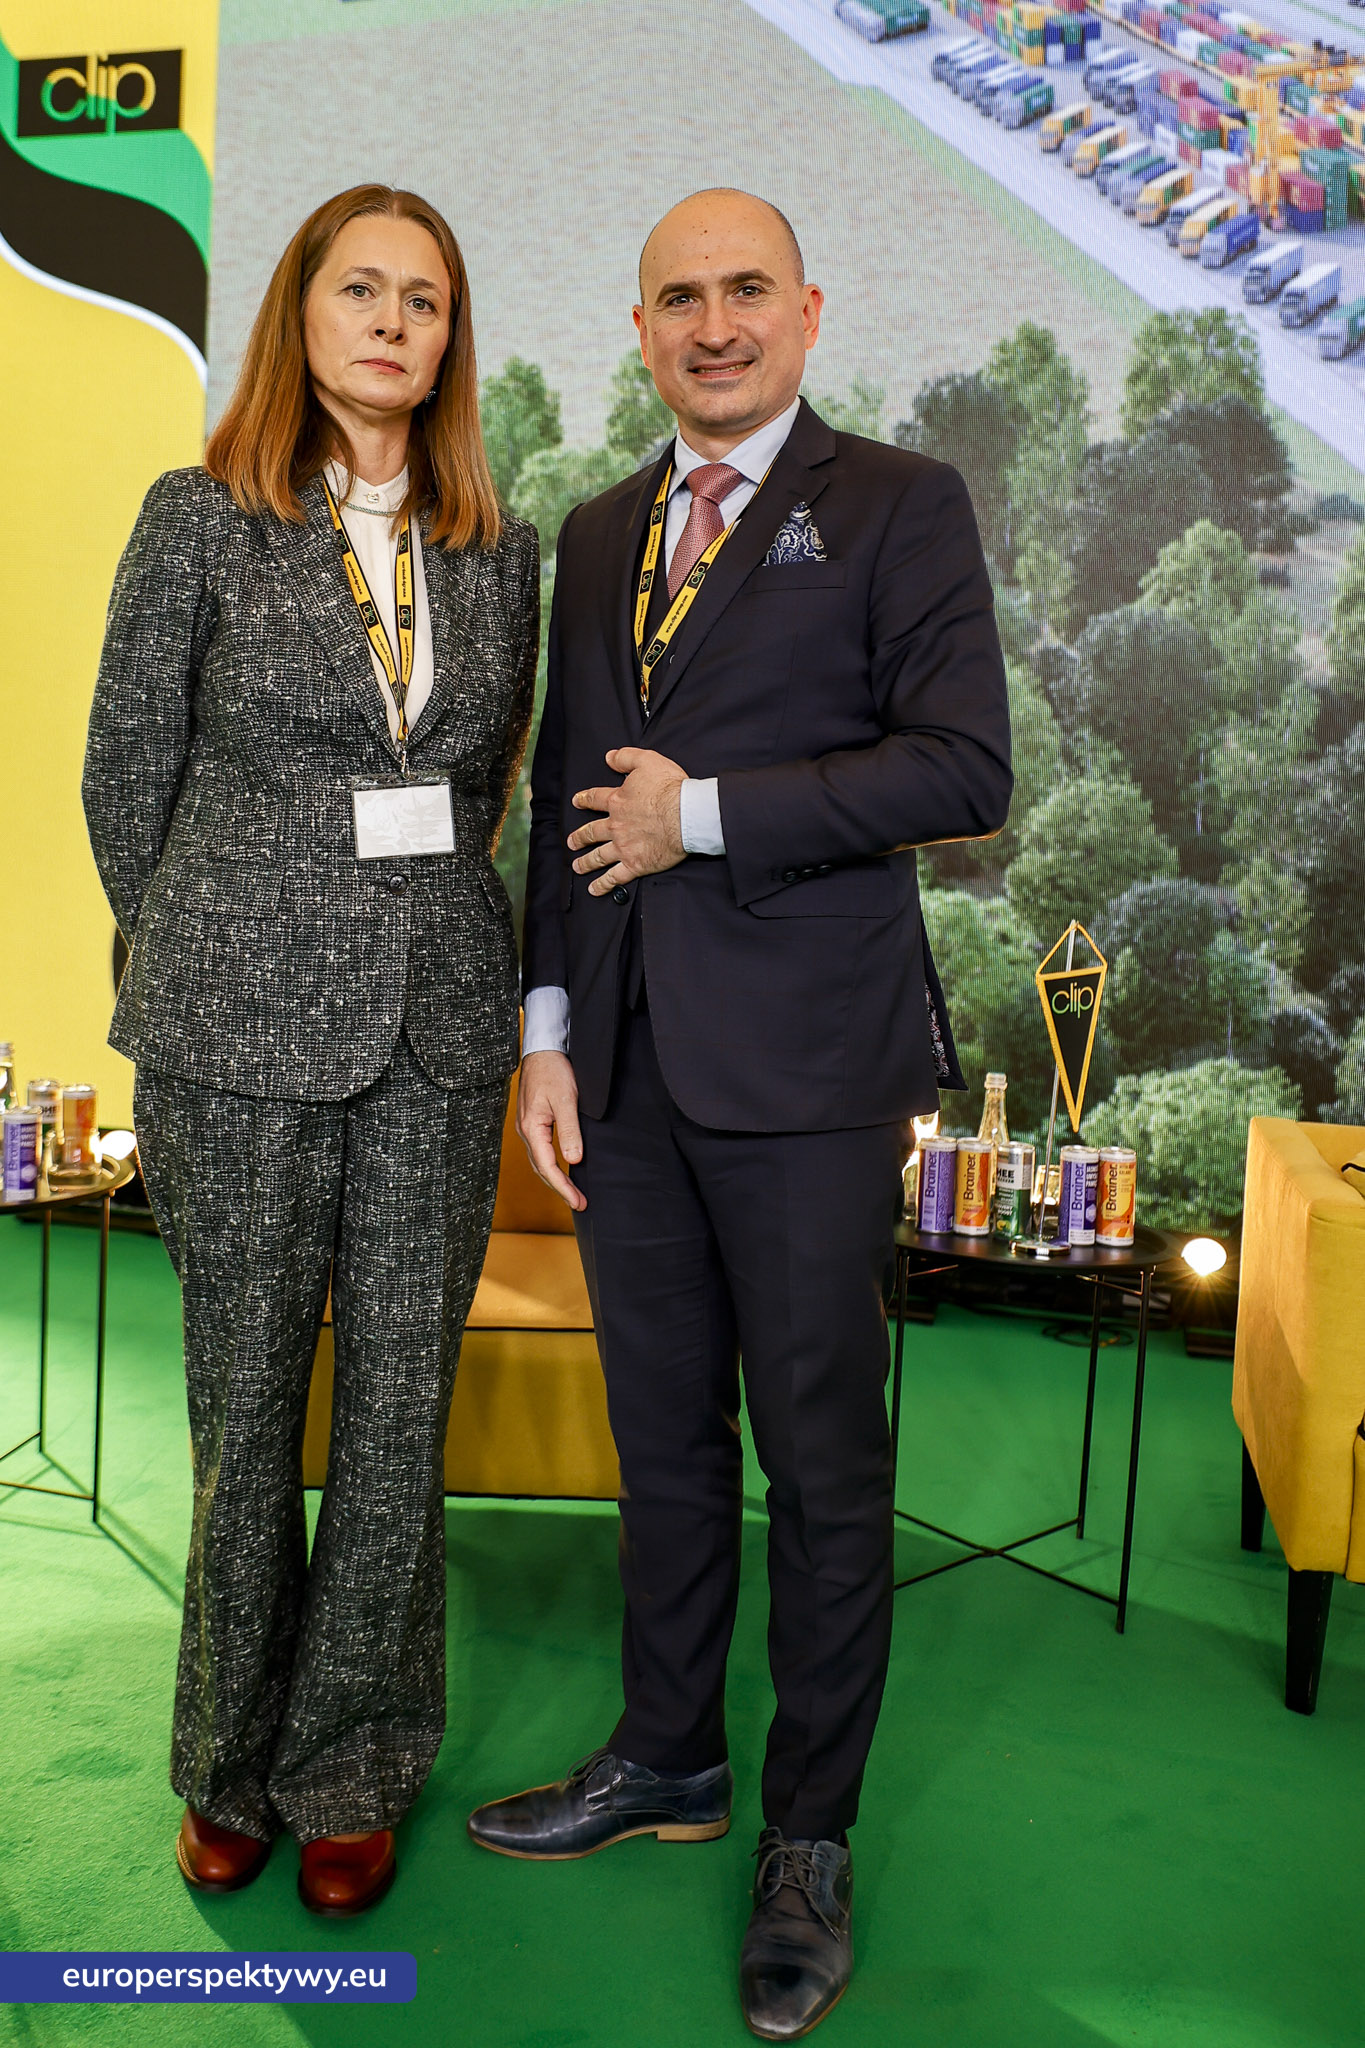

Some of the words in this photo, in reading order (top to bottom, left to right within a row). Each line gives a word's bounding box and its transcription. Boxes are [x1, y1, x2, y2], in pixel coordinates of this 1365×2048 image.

[41, 54, 156, 135] clip
[691, 565, 706, 585] clip
[363, 605, 376, 624] clip
[400, 608, 412, 626] clip
[646, 644, 662, 663] clip
[1052, 982, 1094, 1019] clip
[996, 1168, 1015, 1179] HEE
